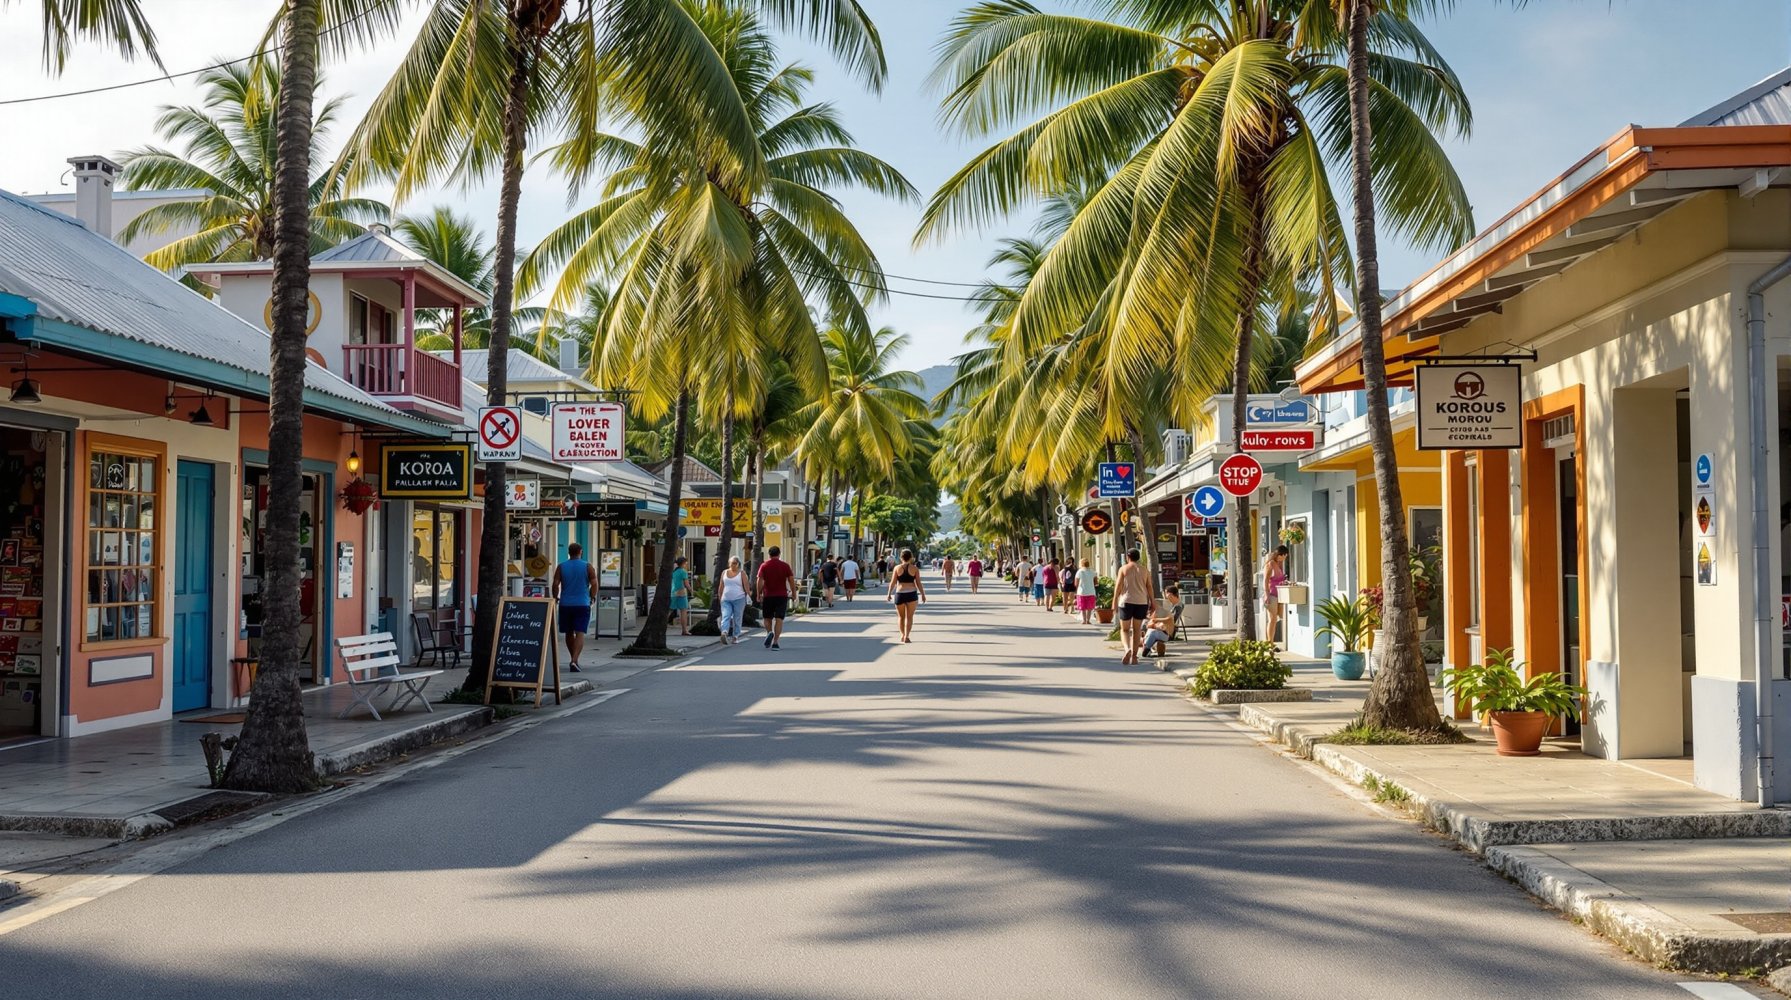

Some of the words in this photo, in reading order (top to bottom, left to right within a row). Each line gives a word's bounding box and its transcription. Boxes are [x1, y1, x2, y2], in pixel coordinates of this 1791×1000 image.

[580, 407, 597, 415] THE
[1436, 402, 1506, 413] KOROUS
[568, 419, 610, 429] LOVER
[1447, 415, 1492, 423] MOROU
[1223, 467, 1259, 478] STOP
